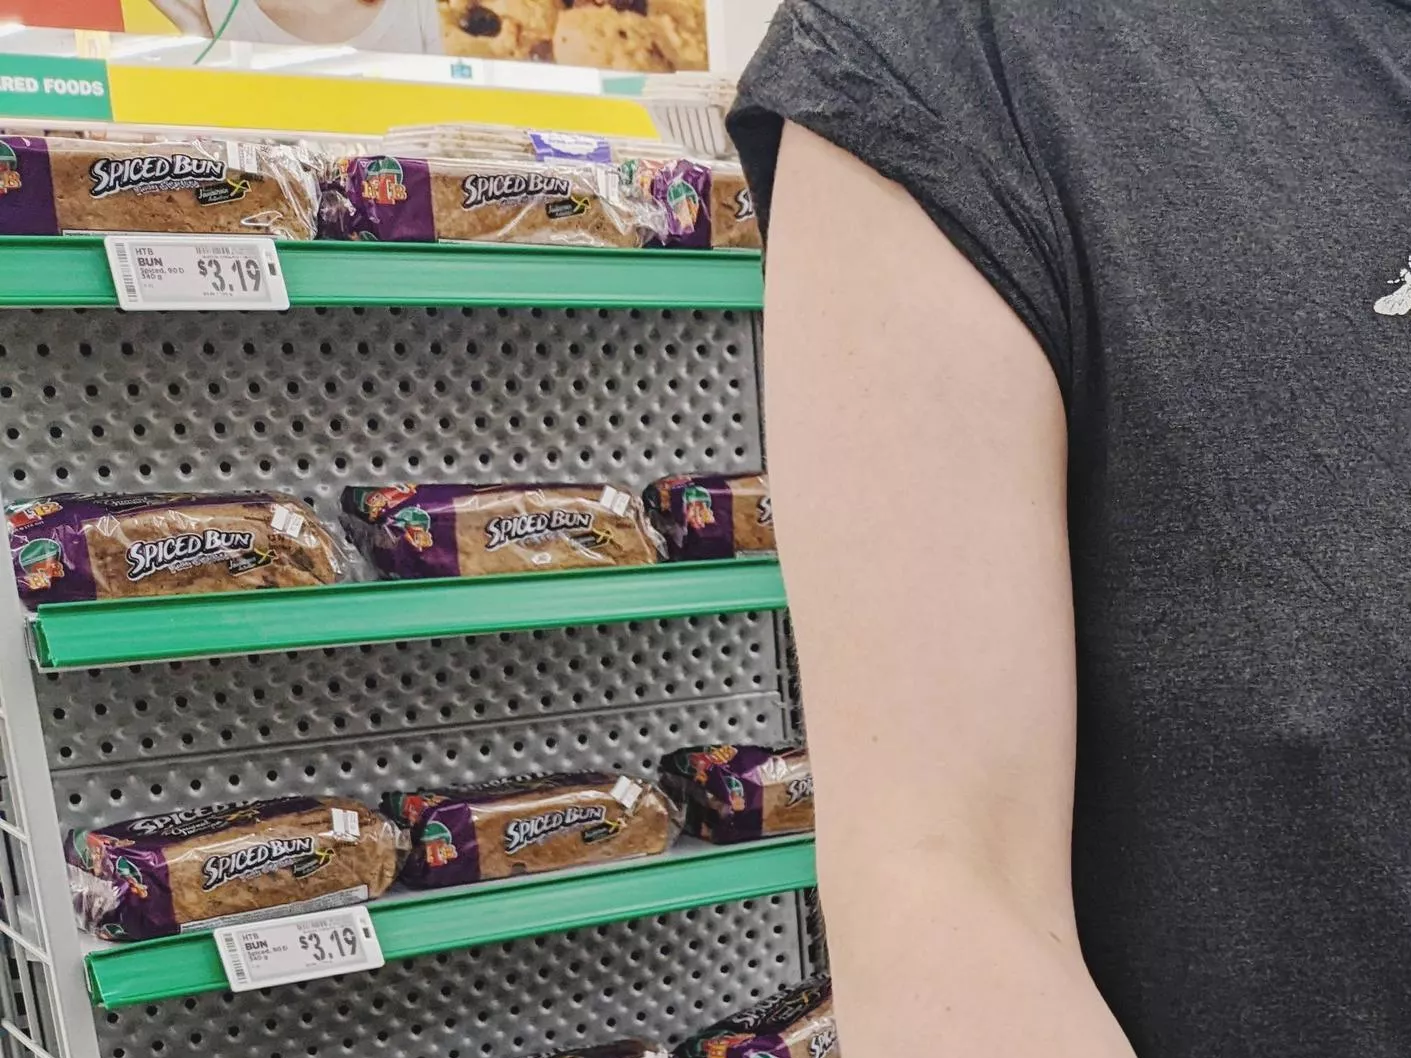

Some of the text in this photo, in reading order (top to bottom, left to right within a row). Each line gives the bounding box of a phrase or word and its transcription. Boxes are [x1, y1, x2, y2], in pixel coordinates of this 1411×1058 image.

[0, 76, 105, 96] RED FOODS
[91, 155, 170, 198] SPICED
[173, 154, 226, 180] BUN
[463, 173, 570, 208] SPICED BUN
[138, 257, 163, 267] BUN
[198, 259, 262, 292] $3.19
[485, 508, 595, 550] SPICED BUN
[127, 535, 202, 581] SPICED
[203, 529, 254, 553] BUN
[505, 805, 604, 854] SPICED BUN
[203, 836, 315, 892] SPICED BUN
[245, 940, 268, 951] BUN
[299, 926, 357, 962] $3.19
